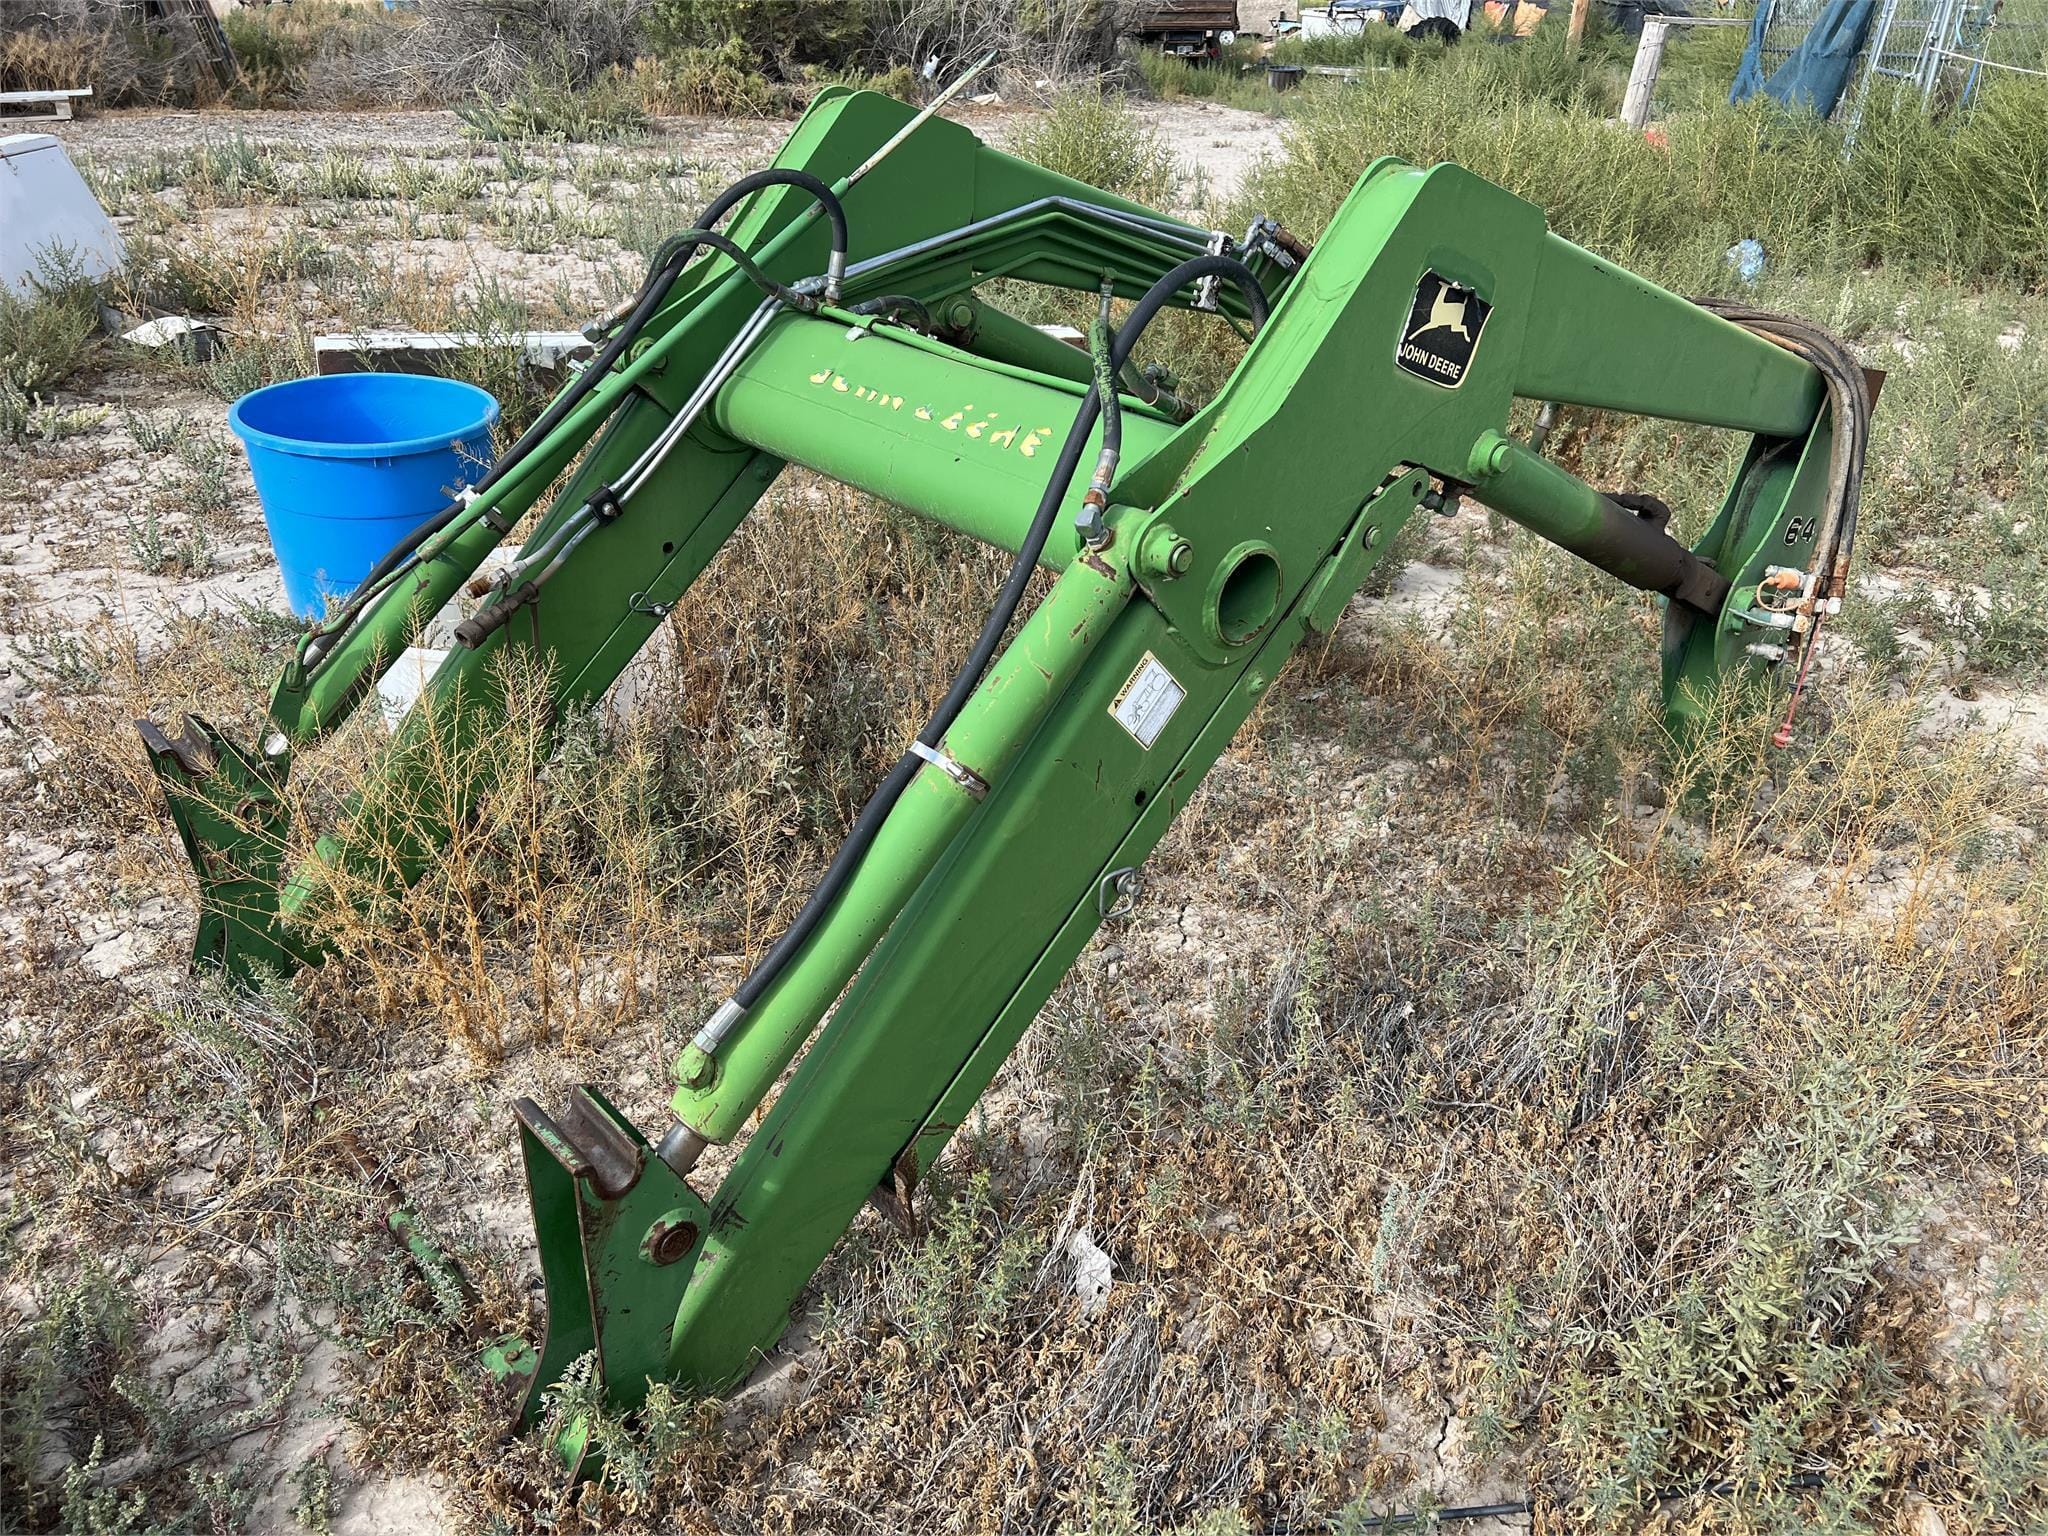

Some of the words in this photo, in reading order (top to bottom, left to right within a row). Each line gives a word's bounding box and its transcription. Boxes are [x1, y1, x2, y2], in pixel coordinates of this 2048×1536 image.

[1401, 343, 1429, 366] JOHN
[1429, 354, 1461, 379] DEERE
[1120, 658, 1149, 697] WARNING
